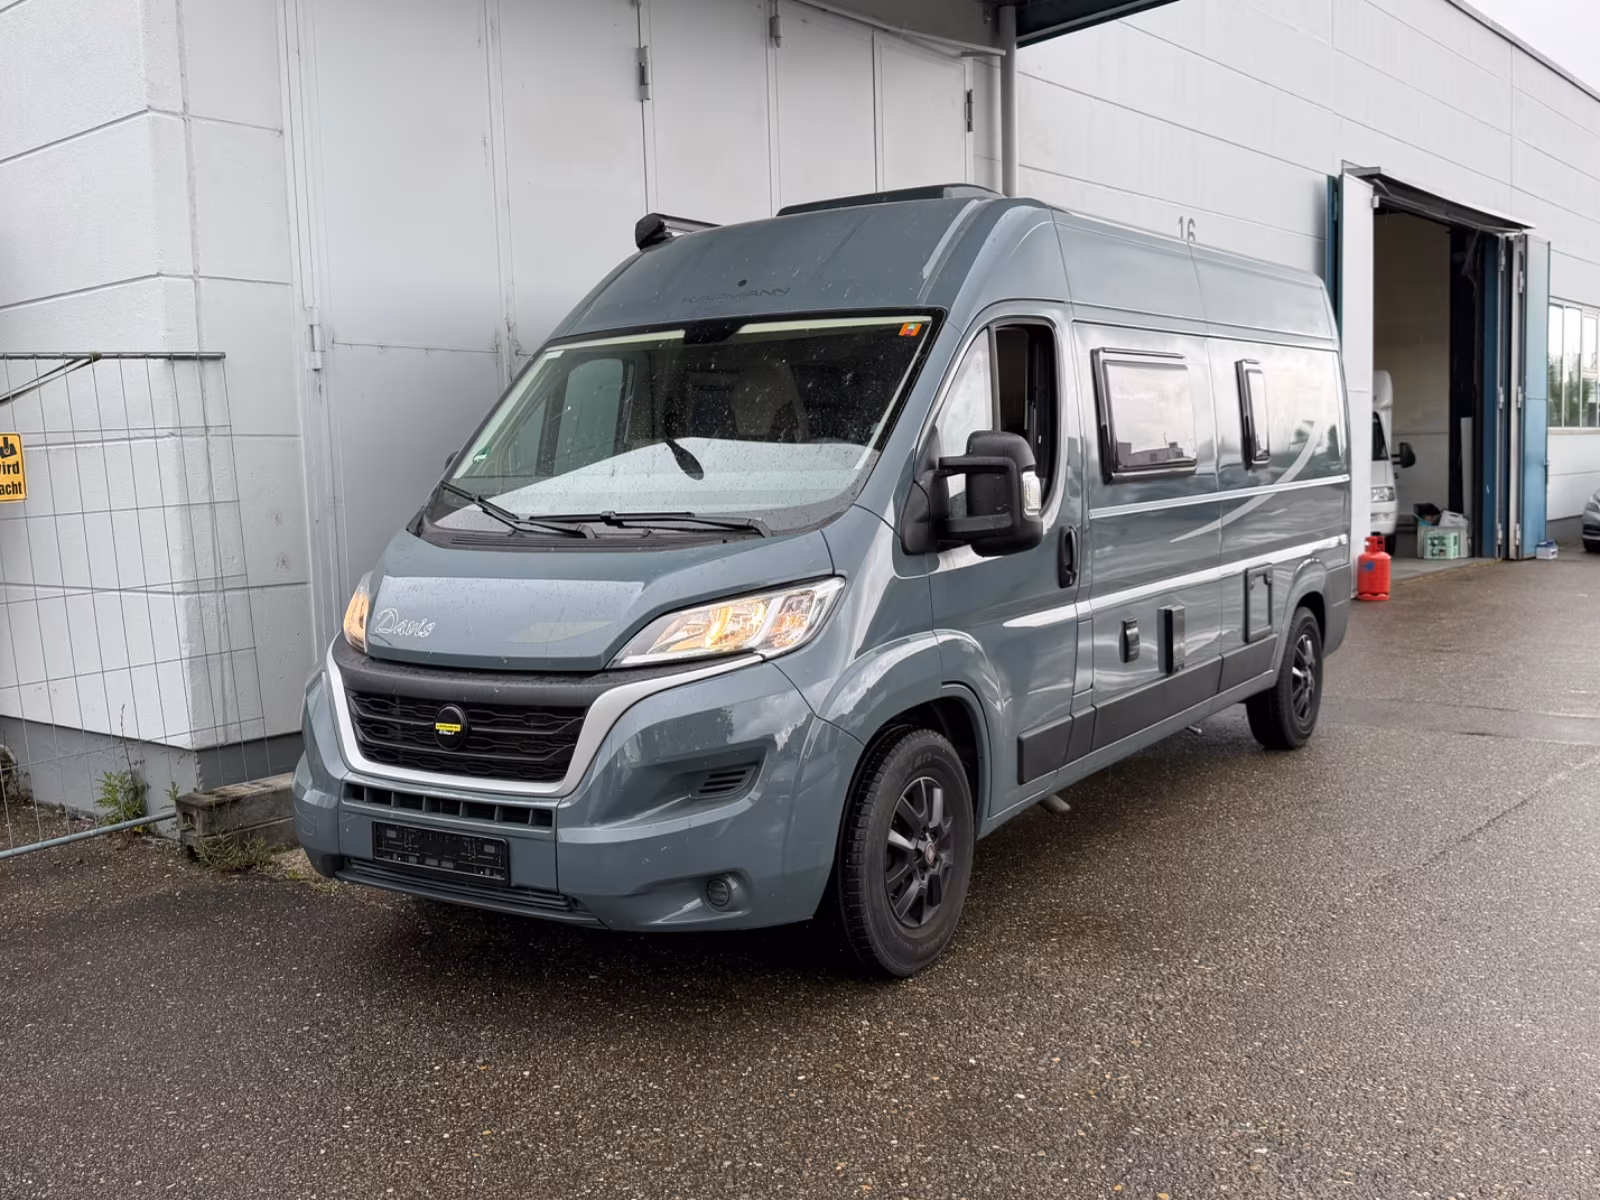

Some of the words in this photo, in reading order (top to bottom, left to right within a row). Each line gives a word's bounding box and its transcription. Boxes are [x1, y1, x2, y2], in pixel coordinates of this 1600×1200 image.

[1178, 215, 1196, 242] 16
[0, 461, 20, 475] ird
[375, 607, 436, 638] Davis
